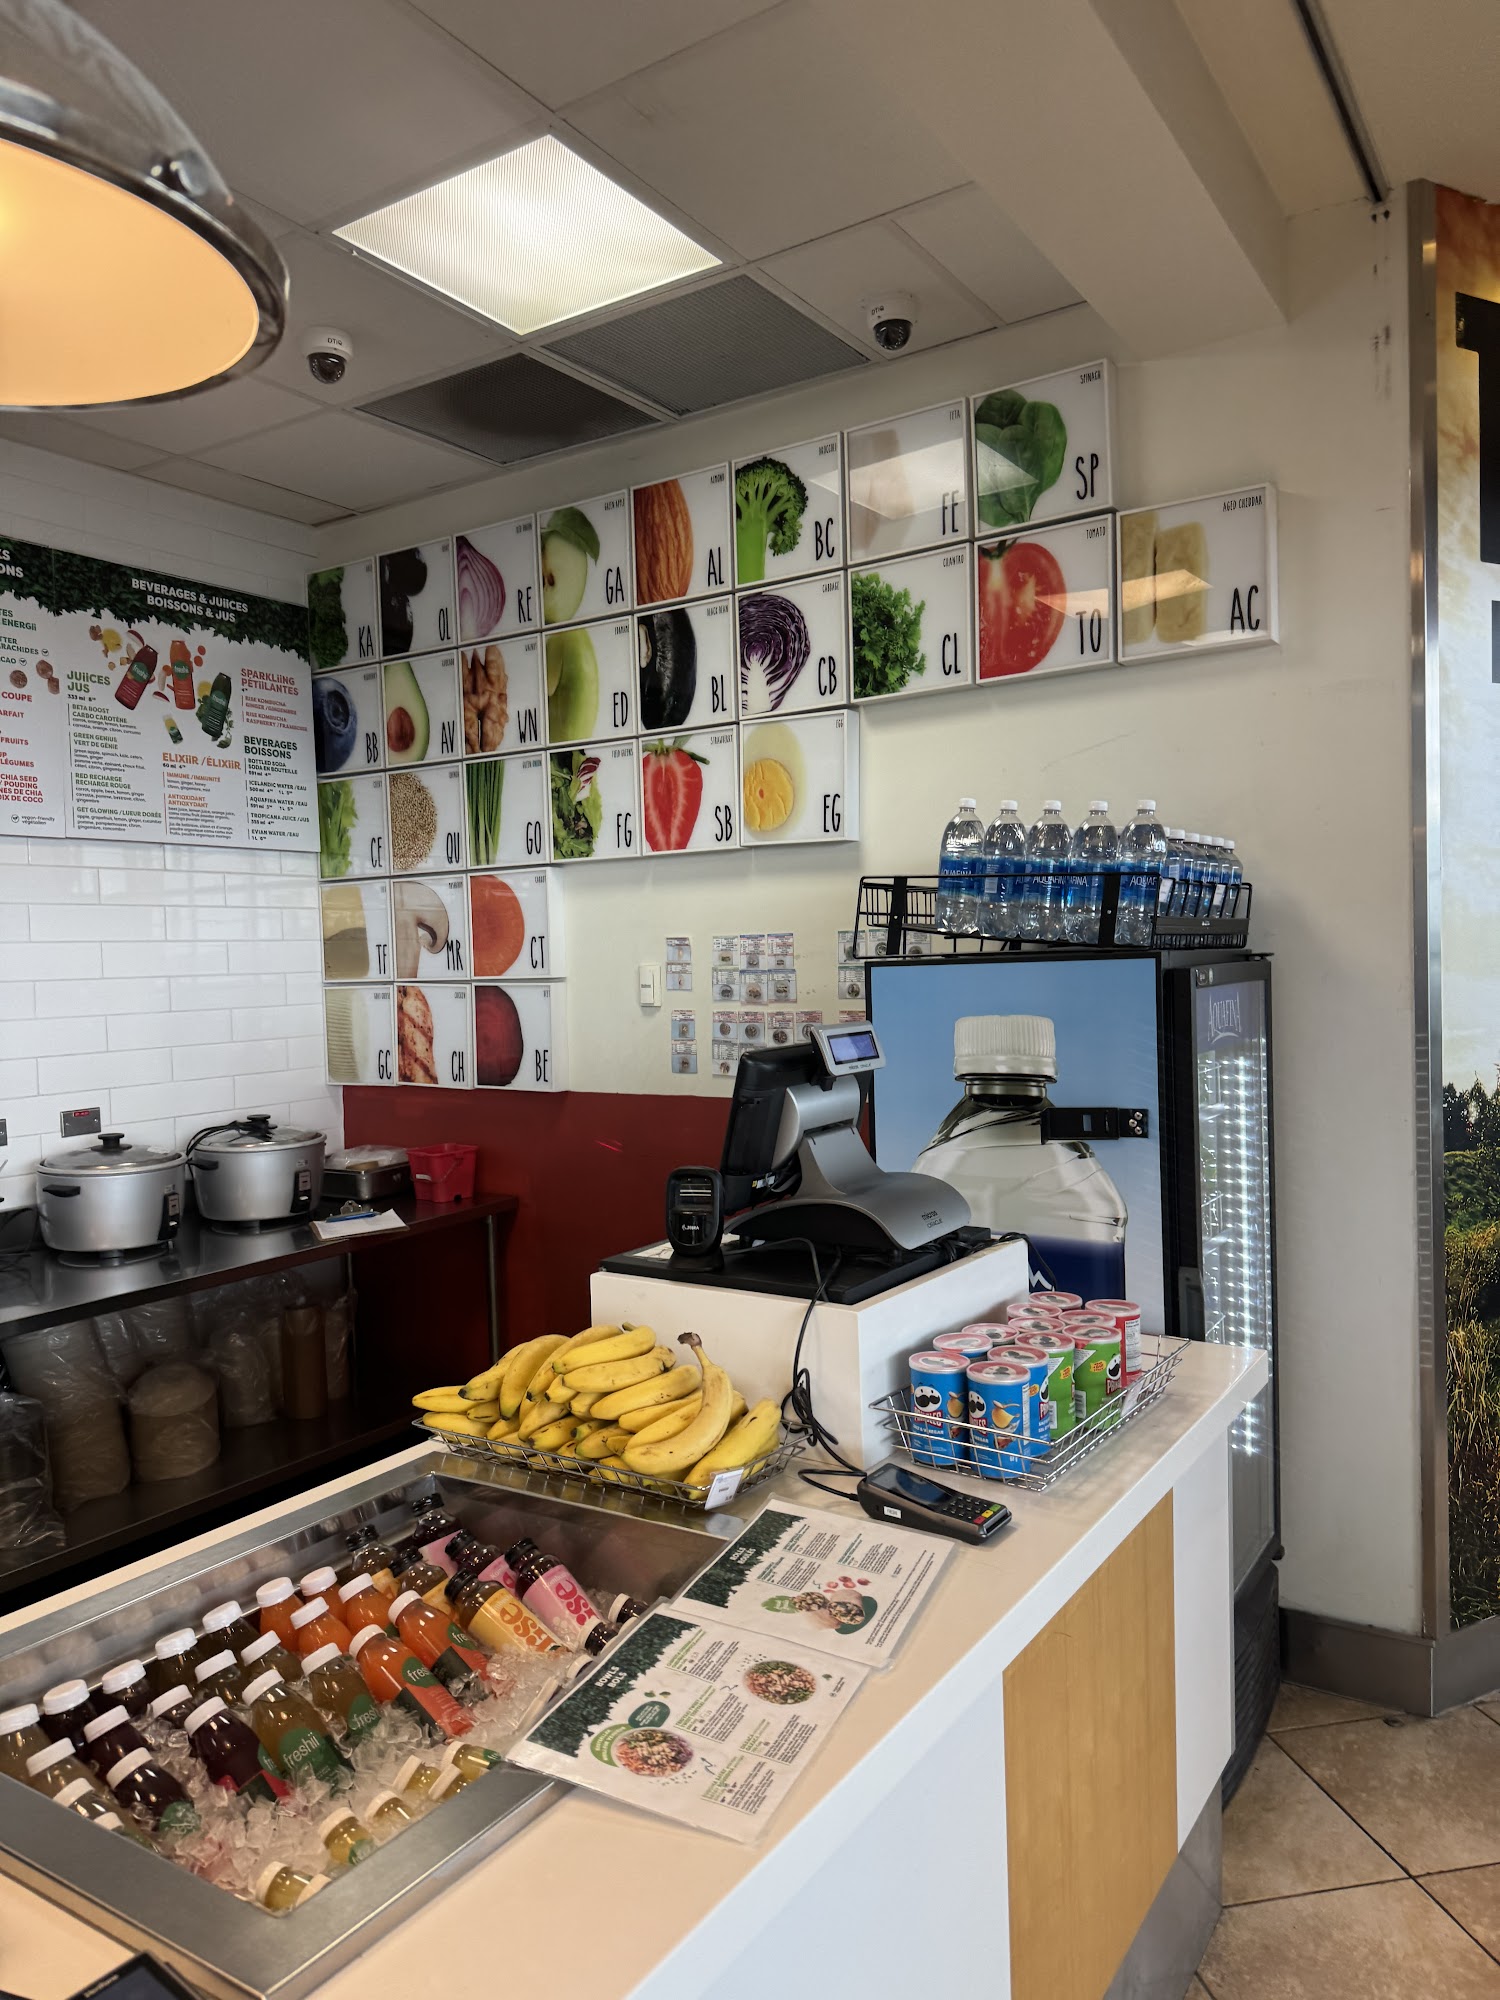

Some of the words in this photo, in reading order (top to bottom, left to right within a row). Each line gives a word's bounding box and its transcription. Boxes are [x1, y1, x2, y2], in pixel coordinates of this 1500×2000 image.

[1080, 370, 1101, 384] SPINACH
[949, 409, 960, 421] FETA
[819, 442, 837, 456] BROCCOLI
[710, 473, 724, 484] ALMOND
[1076, 453, 1099, 500] SP
[942, 490, 959, 535] FE
[1223, 500, 1237, 512] AGED
[1238, 495, 1262, 509] CHEDDAR
[814, 517, 835, 561] BC
[1086, 526, 1106, 539] TOMATO
[707, 546, 724, 587] AL
[132, 578, 197, 601] BEVERAGES
[199, 594, 208, 604] &
[209, 596, 248, 613] JUiiCES
[606, 566, 624, 605] GA
[822, 581, 840, 593] CABBAGE
[147, 595, 204, 616] BOISSONS
[205, 608, 214, 618] &
[215, 611, 236, 622] JUS
[518, 586, 532, 624] RE
[1230, 585, 1260, 635] AC
[438, 608, 451, 641] OL
[1076, 608, 1102, 655] TO
[0, 642, 39, 655] RACHIDES
[358, 624, 373, 658] KA
[942, 632, 961, 676] CL
[67, 670, 110, 685] JUiiCES
[68, 682, 90, 693] JUS
[241, 668, 295, 686] SPARKLiiNG
[818, 655, 837, 696] CB
[2, 692, 32, 702] COUPE
[711, 674, 727, 713] BL
[72, 711, 94, 719] CARBO
[613, 692, 628, 727] ED
[835, 720, 844, 728] EGG
[74, 732, 94, 740] GREEN
[95, 734, 117, 742] GENIUS
[441, 720, 455, 754] AV
[517, 708, 538, 744] WN
[162, 752, 199, 765] ELIXiiR
[244, 736, 298, 751] BEVERAGES
[244, 746, 291, 759] BOISSONS
[366, 732, 378, 763] BB
[0, 758, 34, 768] LÉGUMES
[248, 758, 271, 766] BOTTLED
[76, 779, 109, 787] RECHARGE
[89, 774, 122, 782] RECHARGE
[249, 780, 276, 788] ICELANDIC
[168, 800, 208, 808] ANTIOXYDANT
[823, 794, 840, 833] EG
[526, 821, 541, 855] GO
[617, 813, 632, 848] FG
[715, 805, 733, 842] SB
[370, 836, 382, 868] CE
[446, 832, 460, 864] QU
[376, 944, 387, 975] TF
[446, 940, 464, 971] MR
[531, 936, 545, 969] CT
[1208, 992, 1241, 1041] AQUAFINA
[378, 1050, 391, 1080] GC
[451, 1050, 464, 1082] CH
[535, 1050, 549, 1082] BE
[729, 1547, 746, 1561] ROLLS
[595, 1665, 620, 1687] BOWLS
[608, 1672, 628, 1688] BOLS
[283, 1732, 320, 1769] freshii
